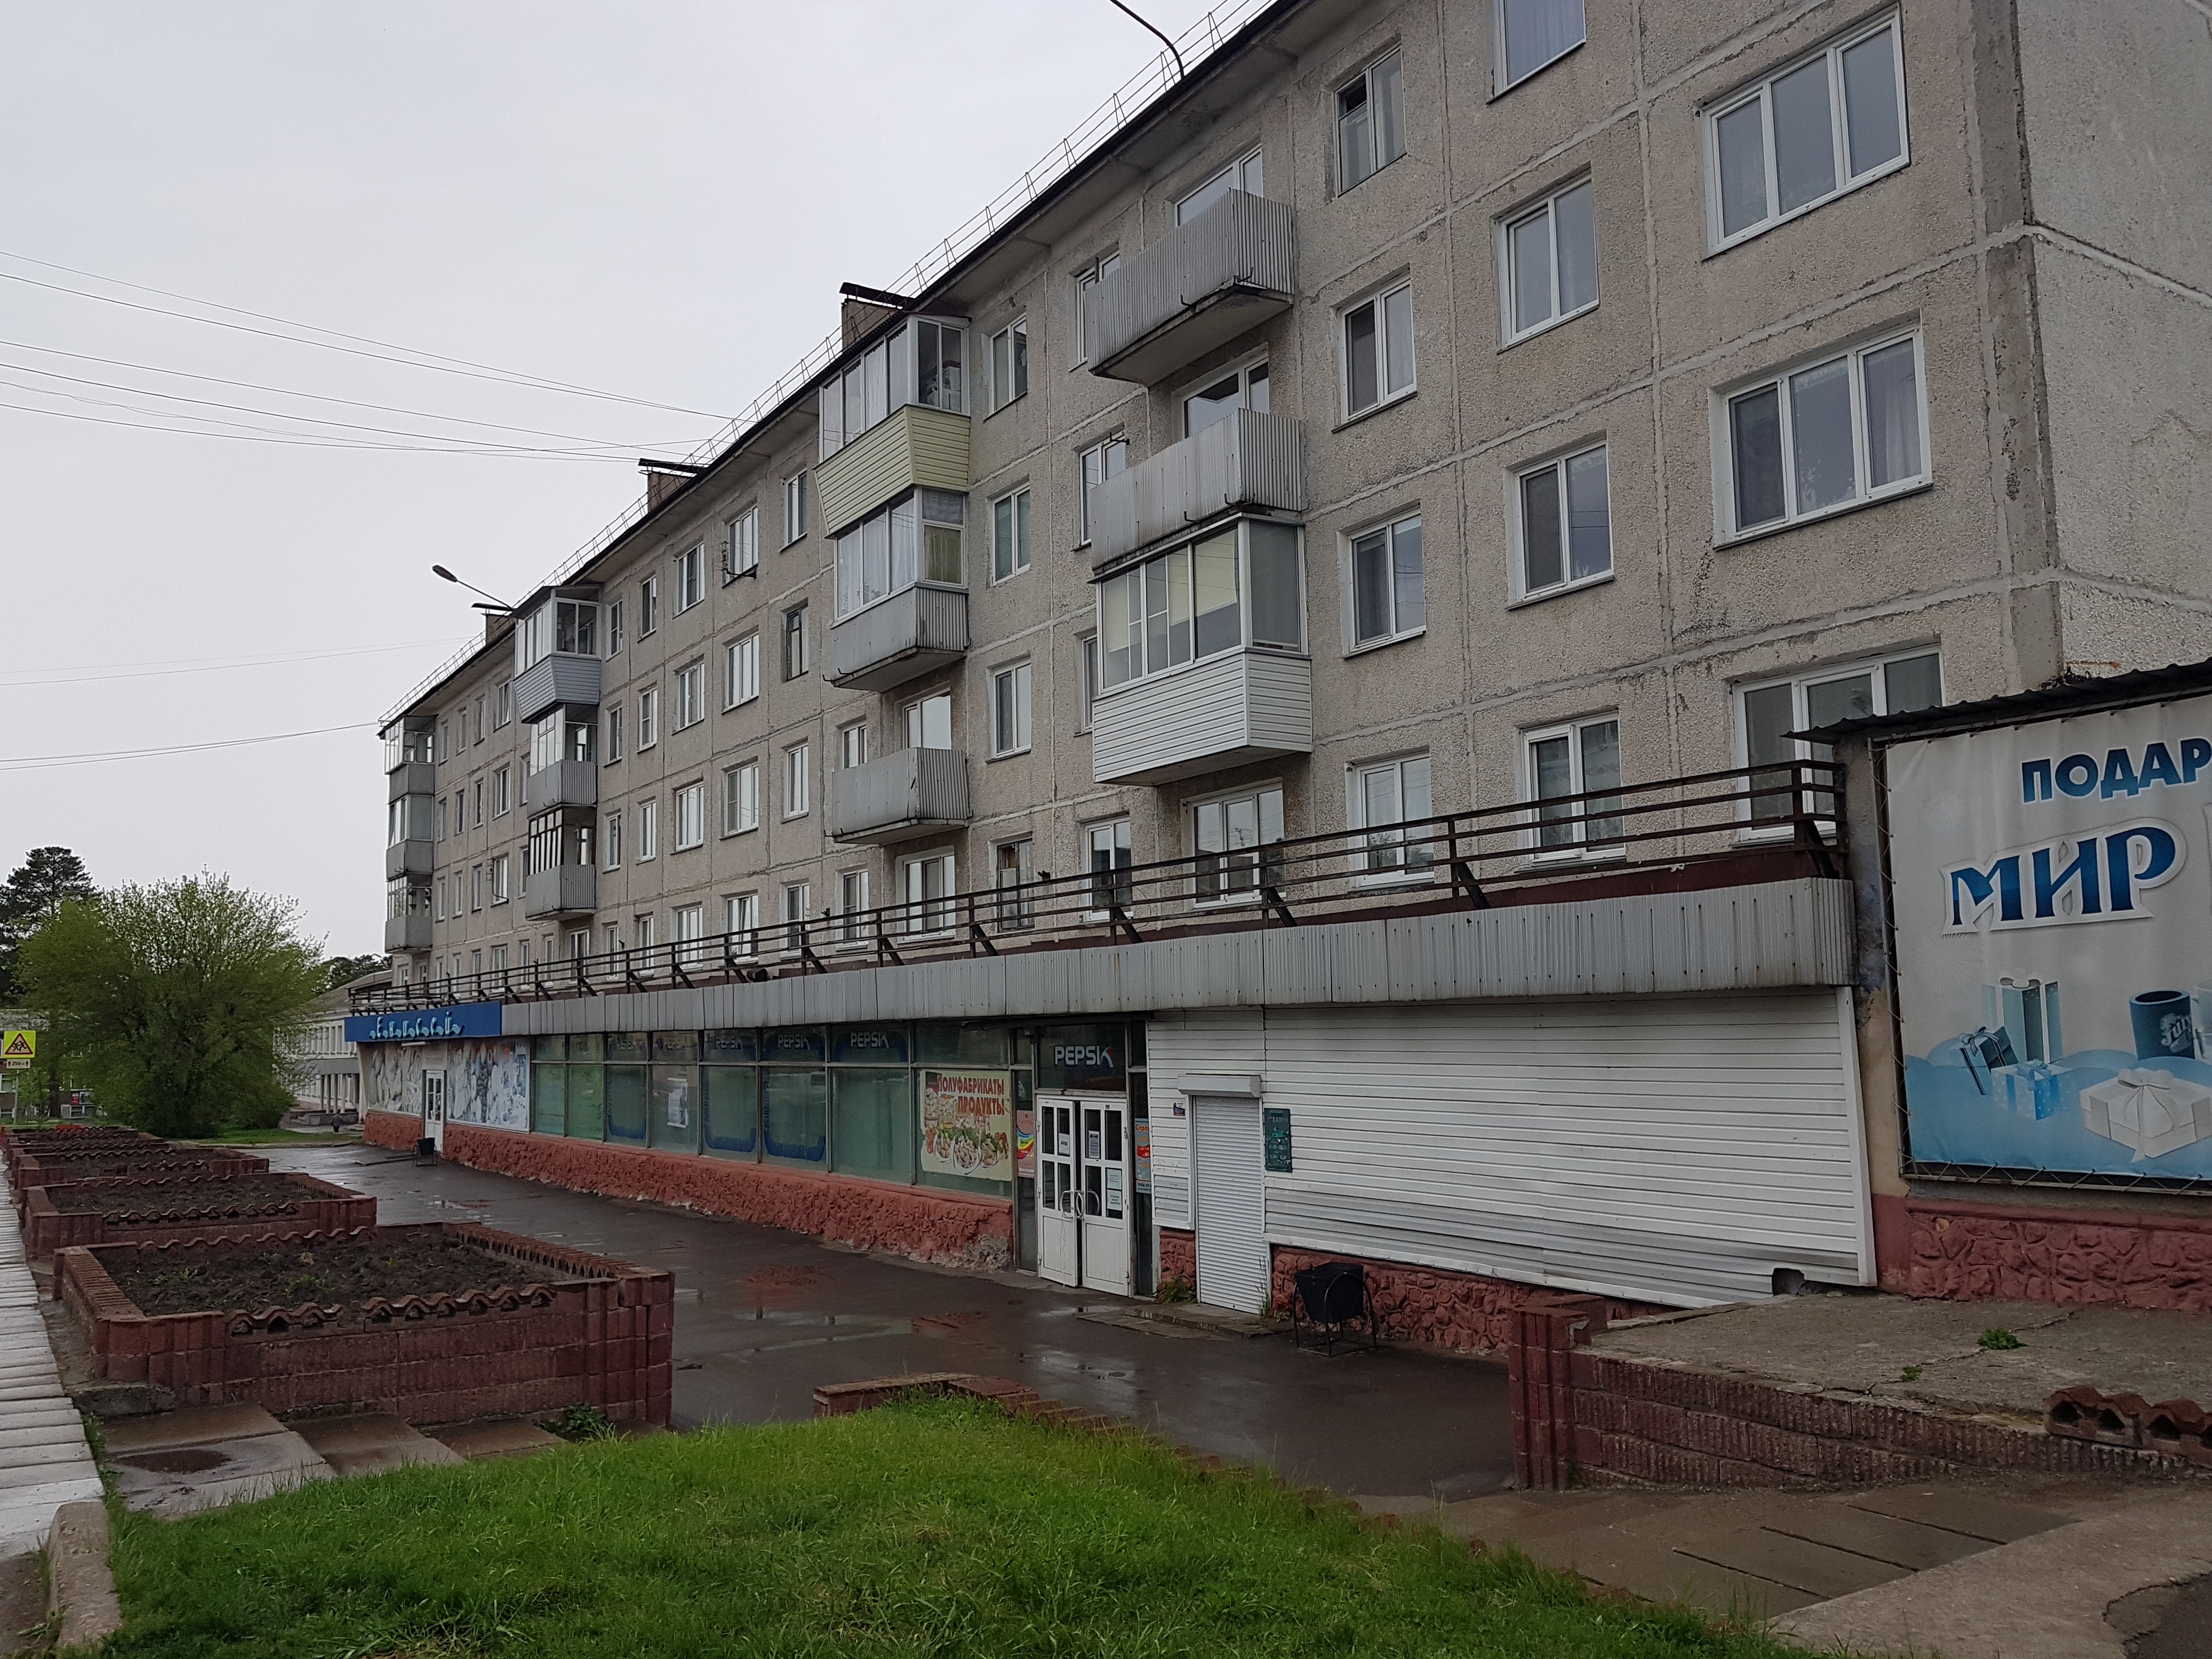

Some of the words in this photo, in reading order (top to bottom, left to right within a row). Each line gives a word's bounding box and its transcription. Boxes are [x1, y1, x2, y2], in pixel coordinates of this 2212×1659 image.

[2021, 738, 2211, 803] ПОДАР
[1950, 827, 2176, 926] МИР
[777, 1034, 804, 1049] PEPSI
[850, 1031, 882, 1048] PEPSI
[1054, 1045, 1101, 1065] PEPSI
[938, 1075, 1005, 1096] ПОЛУФАБРИКАТЫ
[957, 1096, 1005, 1116] ПРОДУКТЫ
